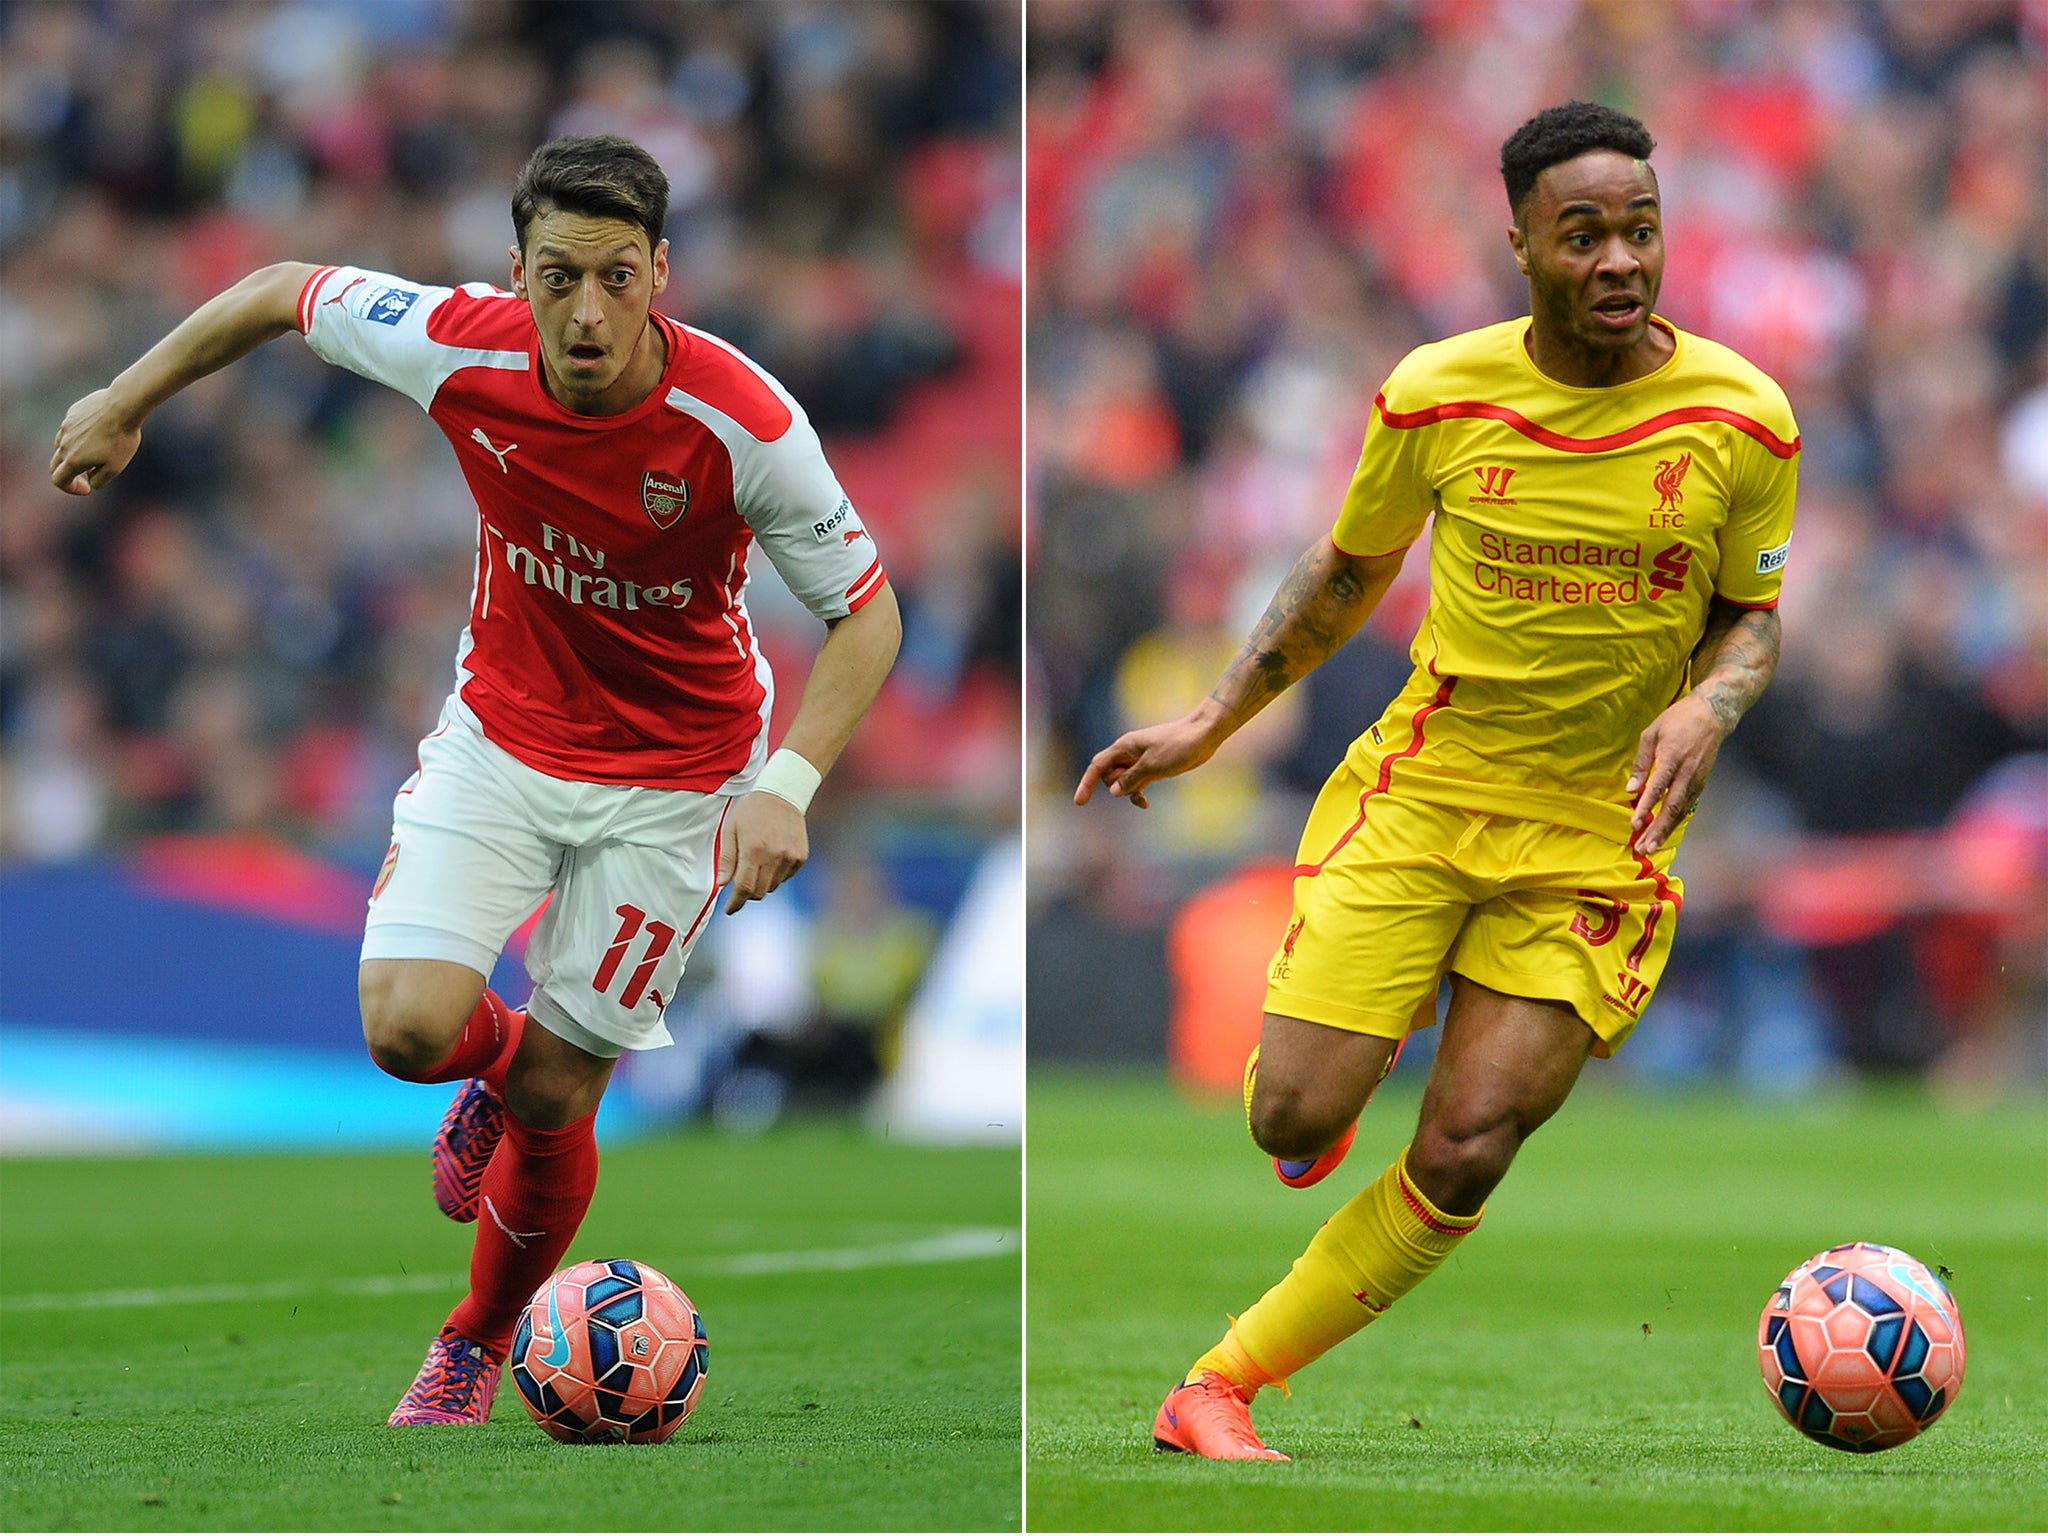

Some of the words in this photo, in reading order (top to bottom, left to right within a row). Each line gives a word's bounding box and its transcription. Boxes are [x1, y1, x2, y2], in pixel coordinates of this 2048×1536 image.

[647, 478, 684, 495] Arsenal
[541, 522, 605, 569] Fly
[1479, 532, 1641, 568] Standard
[1474, 562, 1640, 604] Chartered
[592, 902, 677, 1012] 11
